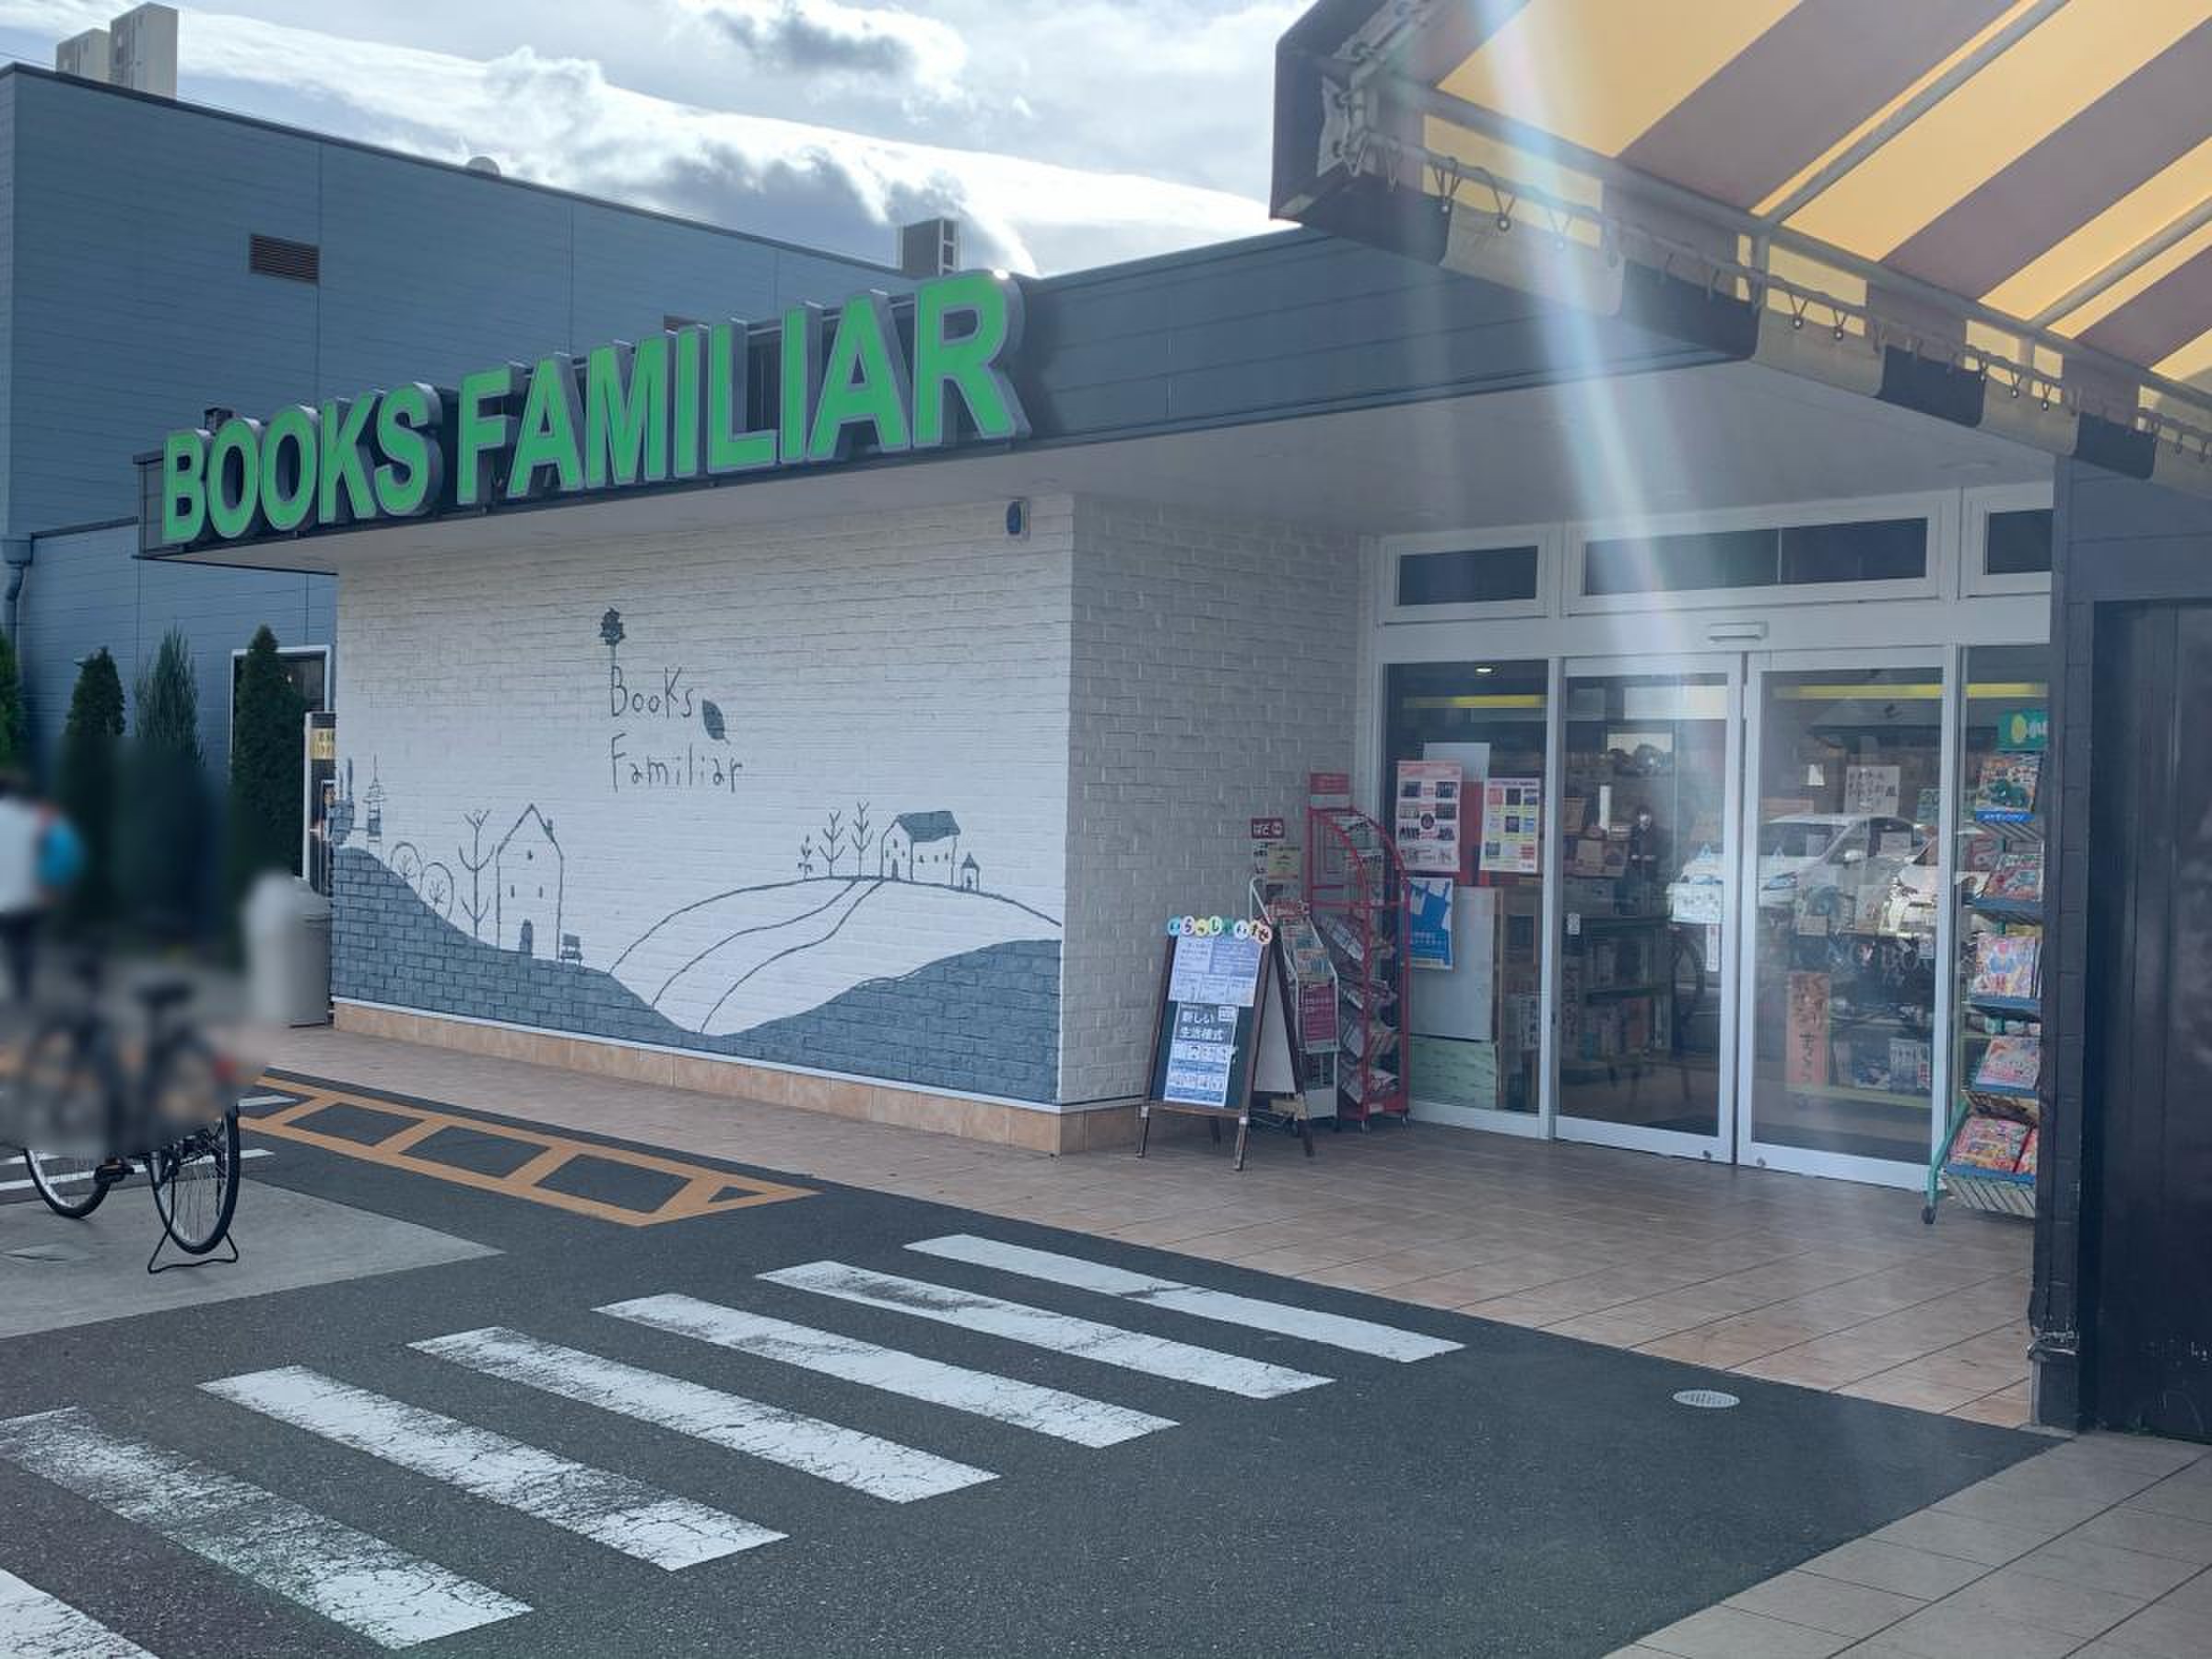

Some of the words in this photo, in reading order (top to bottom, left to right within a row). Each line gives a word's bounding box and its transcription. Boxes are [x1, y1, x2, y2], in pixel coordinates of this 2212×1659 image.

[162, 382, 437, 545] BOOKS
[455, 269, 1025, 506] FAMILIAR
[610, 733, 743, 793] Familiar
